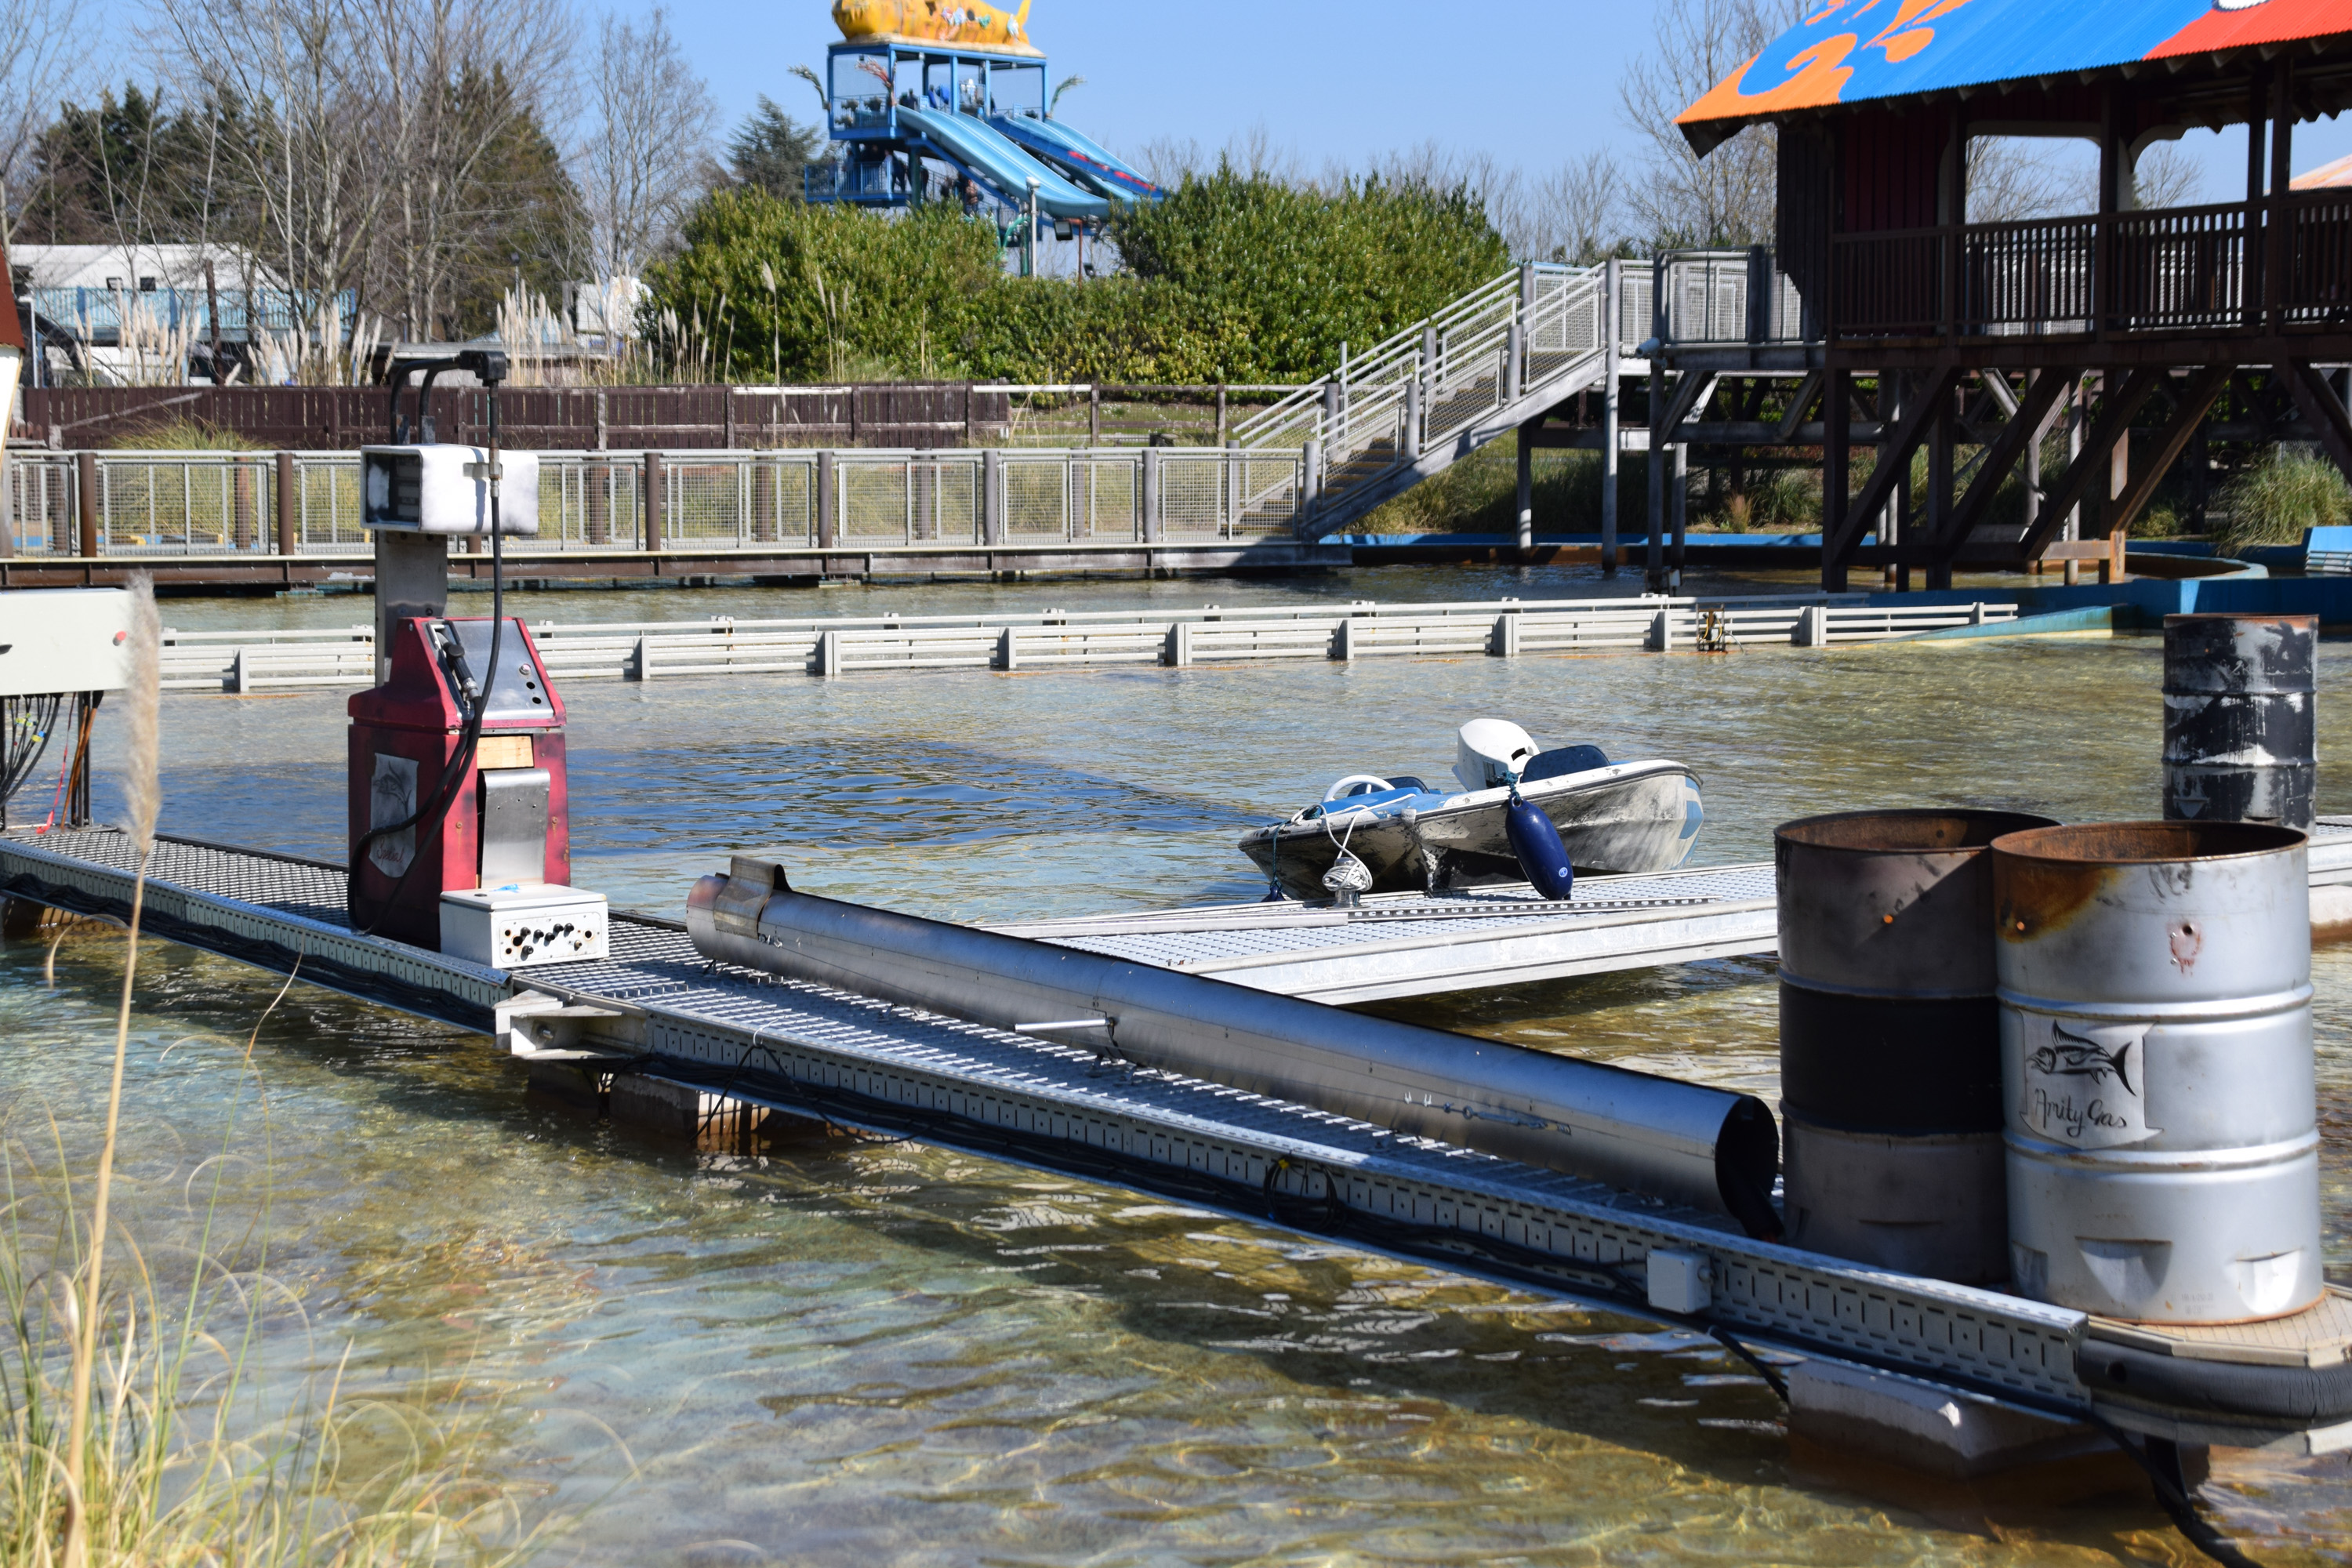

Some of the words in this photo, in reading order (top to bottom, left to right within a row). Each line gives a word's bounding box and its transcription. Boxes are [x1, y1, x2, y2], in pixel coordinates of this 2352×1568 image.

[376, 837, 405, 866] Special
[2034, 1087, 2085, 1138] Amity
[2087, 1099, 2127, 1127] Gas
